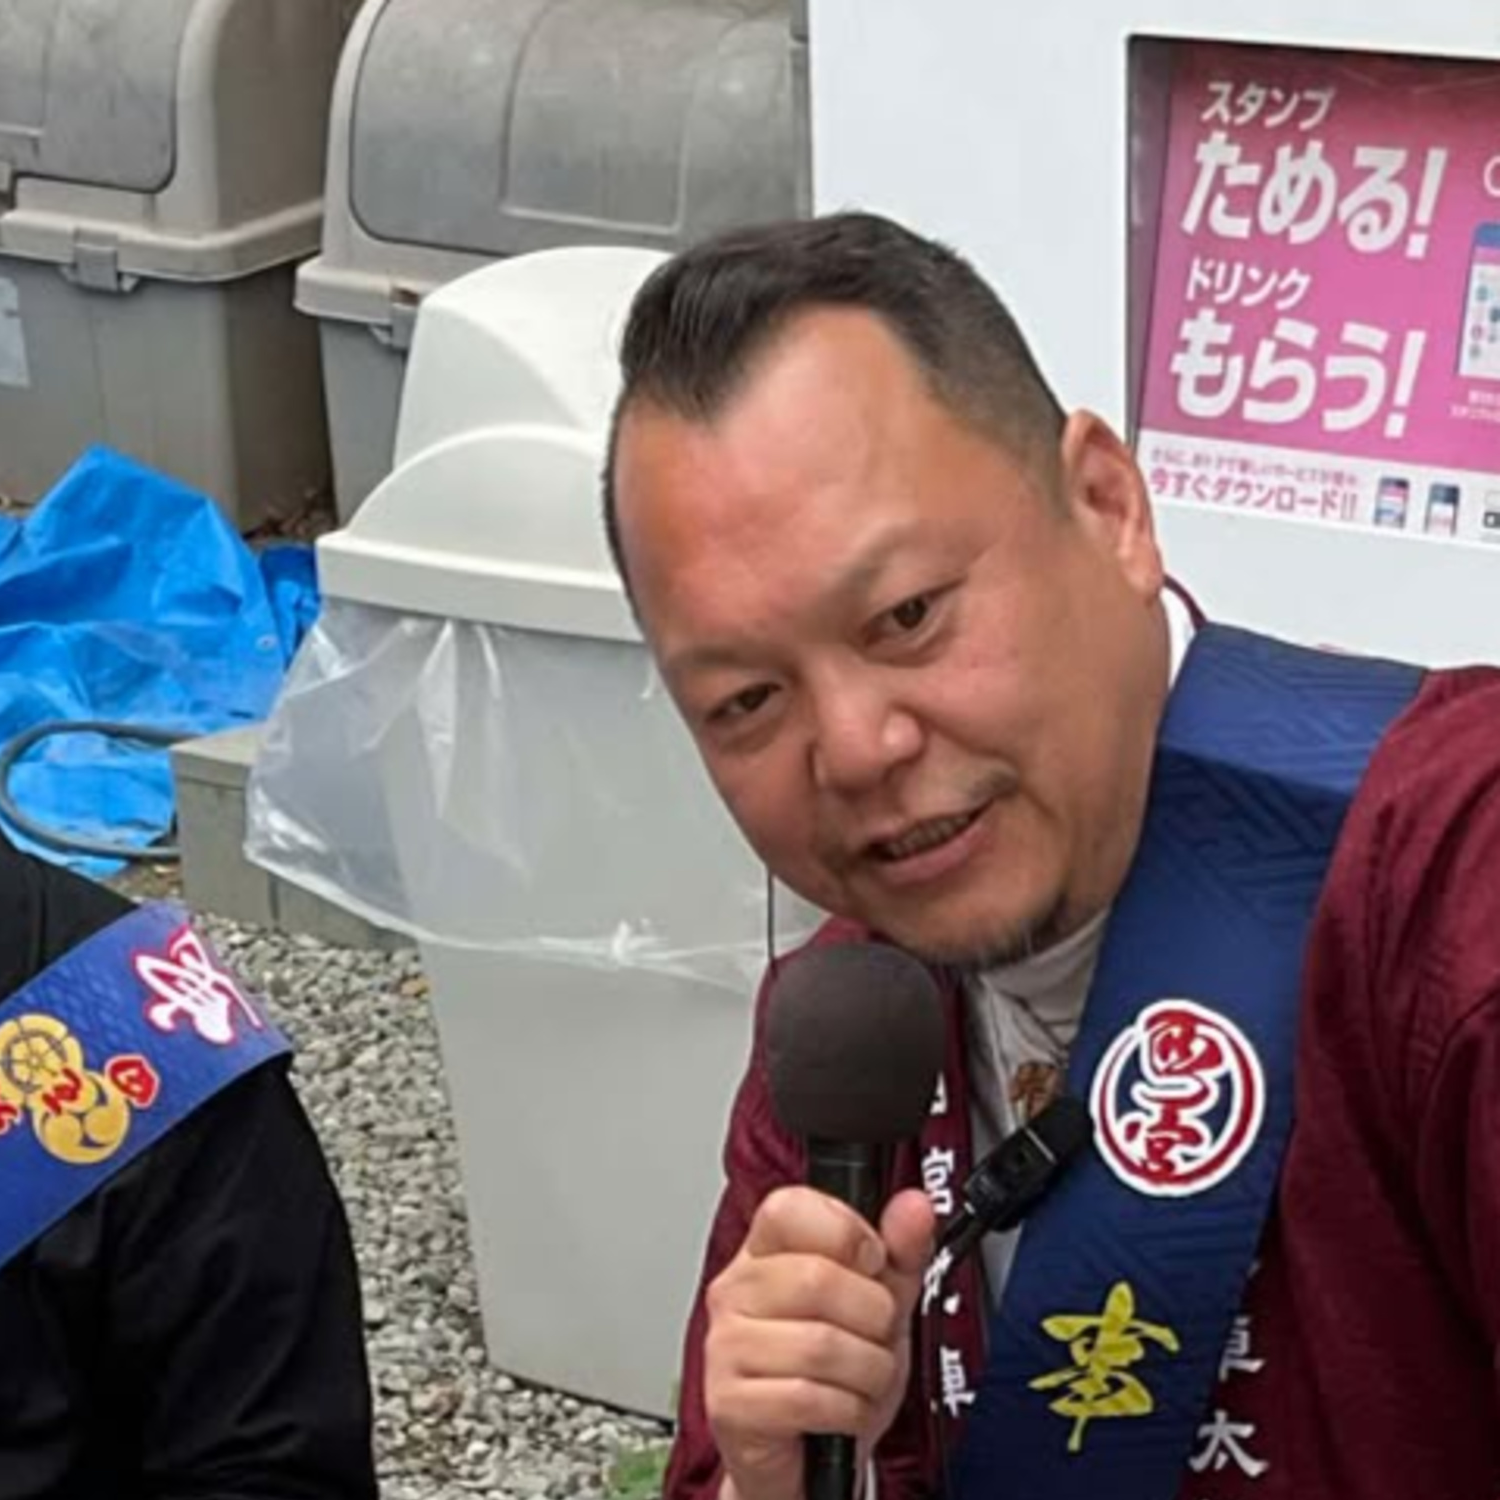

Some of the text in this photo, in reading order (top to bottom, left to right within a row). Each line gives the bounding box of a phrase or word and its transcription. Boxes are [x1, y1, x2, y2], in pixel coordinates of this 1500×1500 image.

[1202, 81, 1333, 130] スタンプ
[1181, 131, 1447, 259] ためる!
[1186, 257, 1310, 310] ドリンク
[1170, 307, 1426, 438] もらう!
